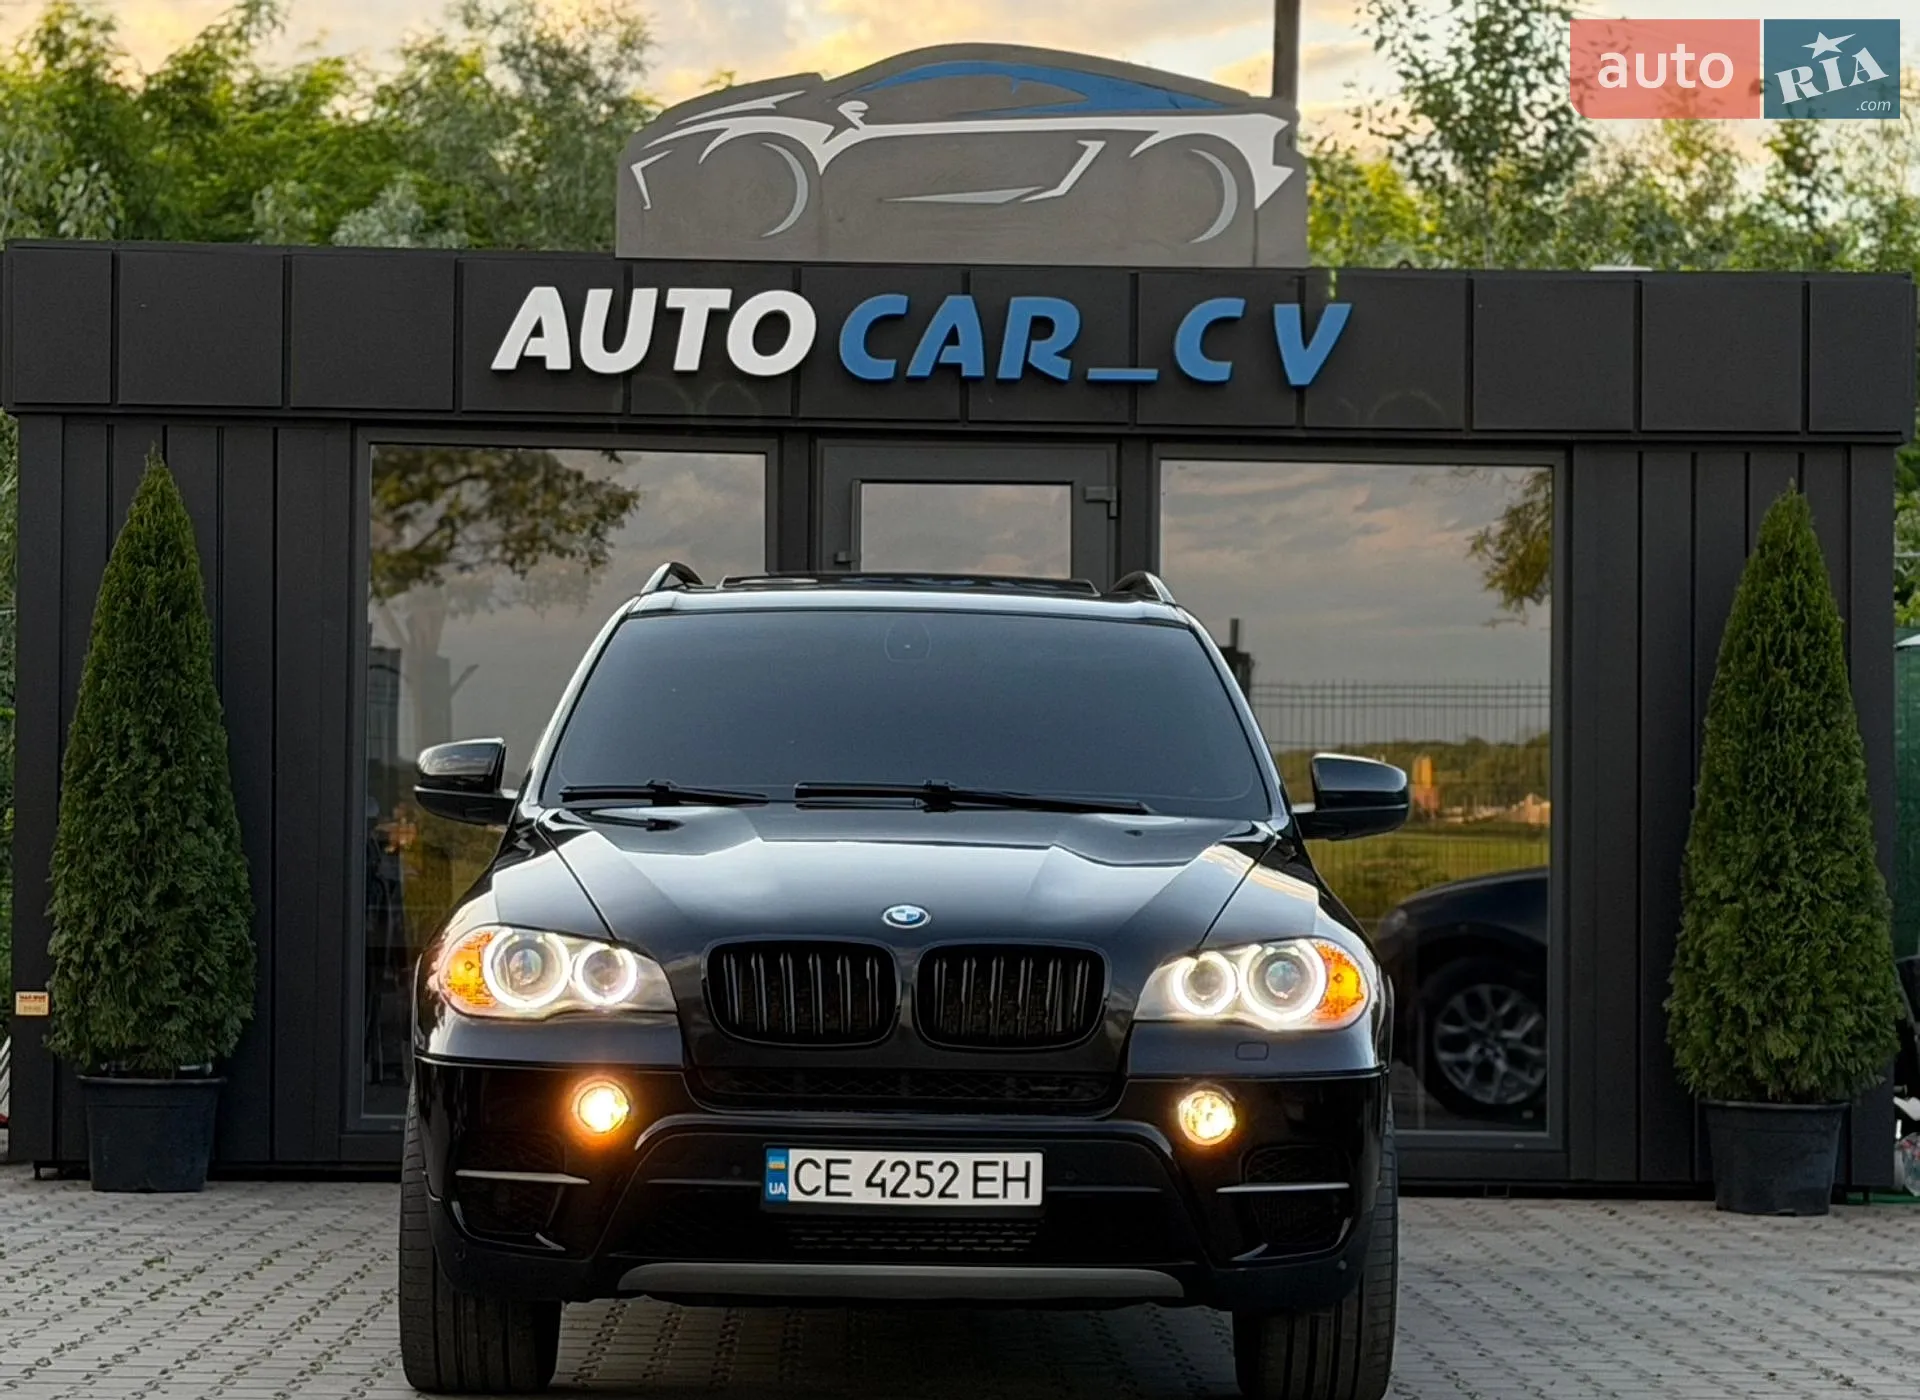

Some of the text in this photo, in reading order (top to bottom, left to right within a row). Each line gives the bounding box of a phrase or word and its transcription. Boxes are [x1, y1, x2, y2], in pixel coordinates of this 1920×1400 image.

[491, 286, 817, 377] AUTO
[769, 1181, 787, 1195] UA
[794, 1158, 1032, 1199] CE 4252 EH
